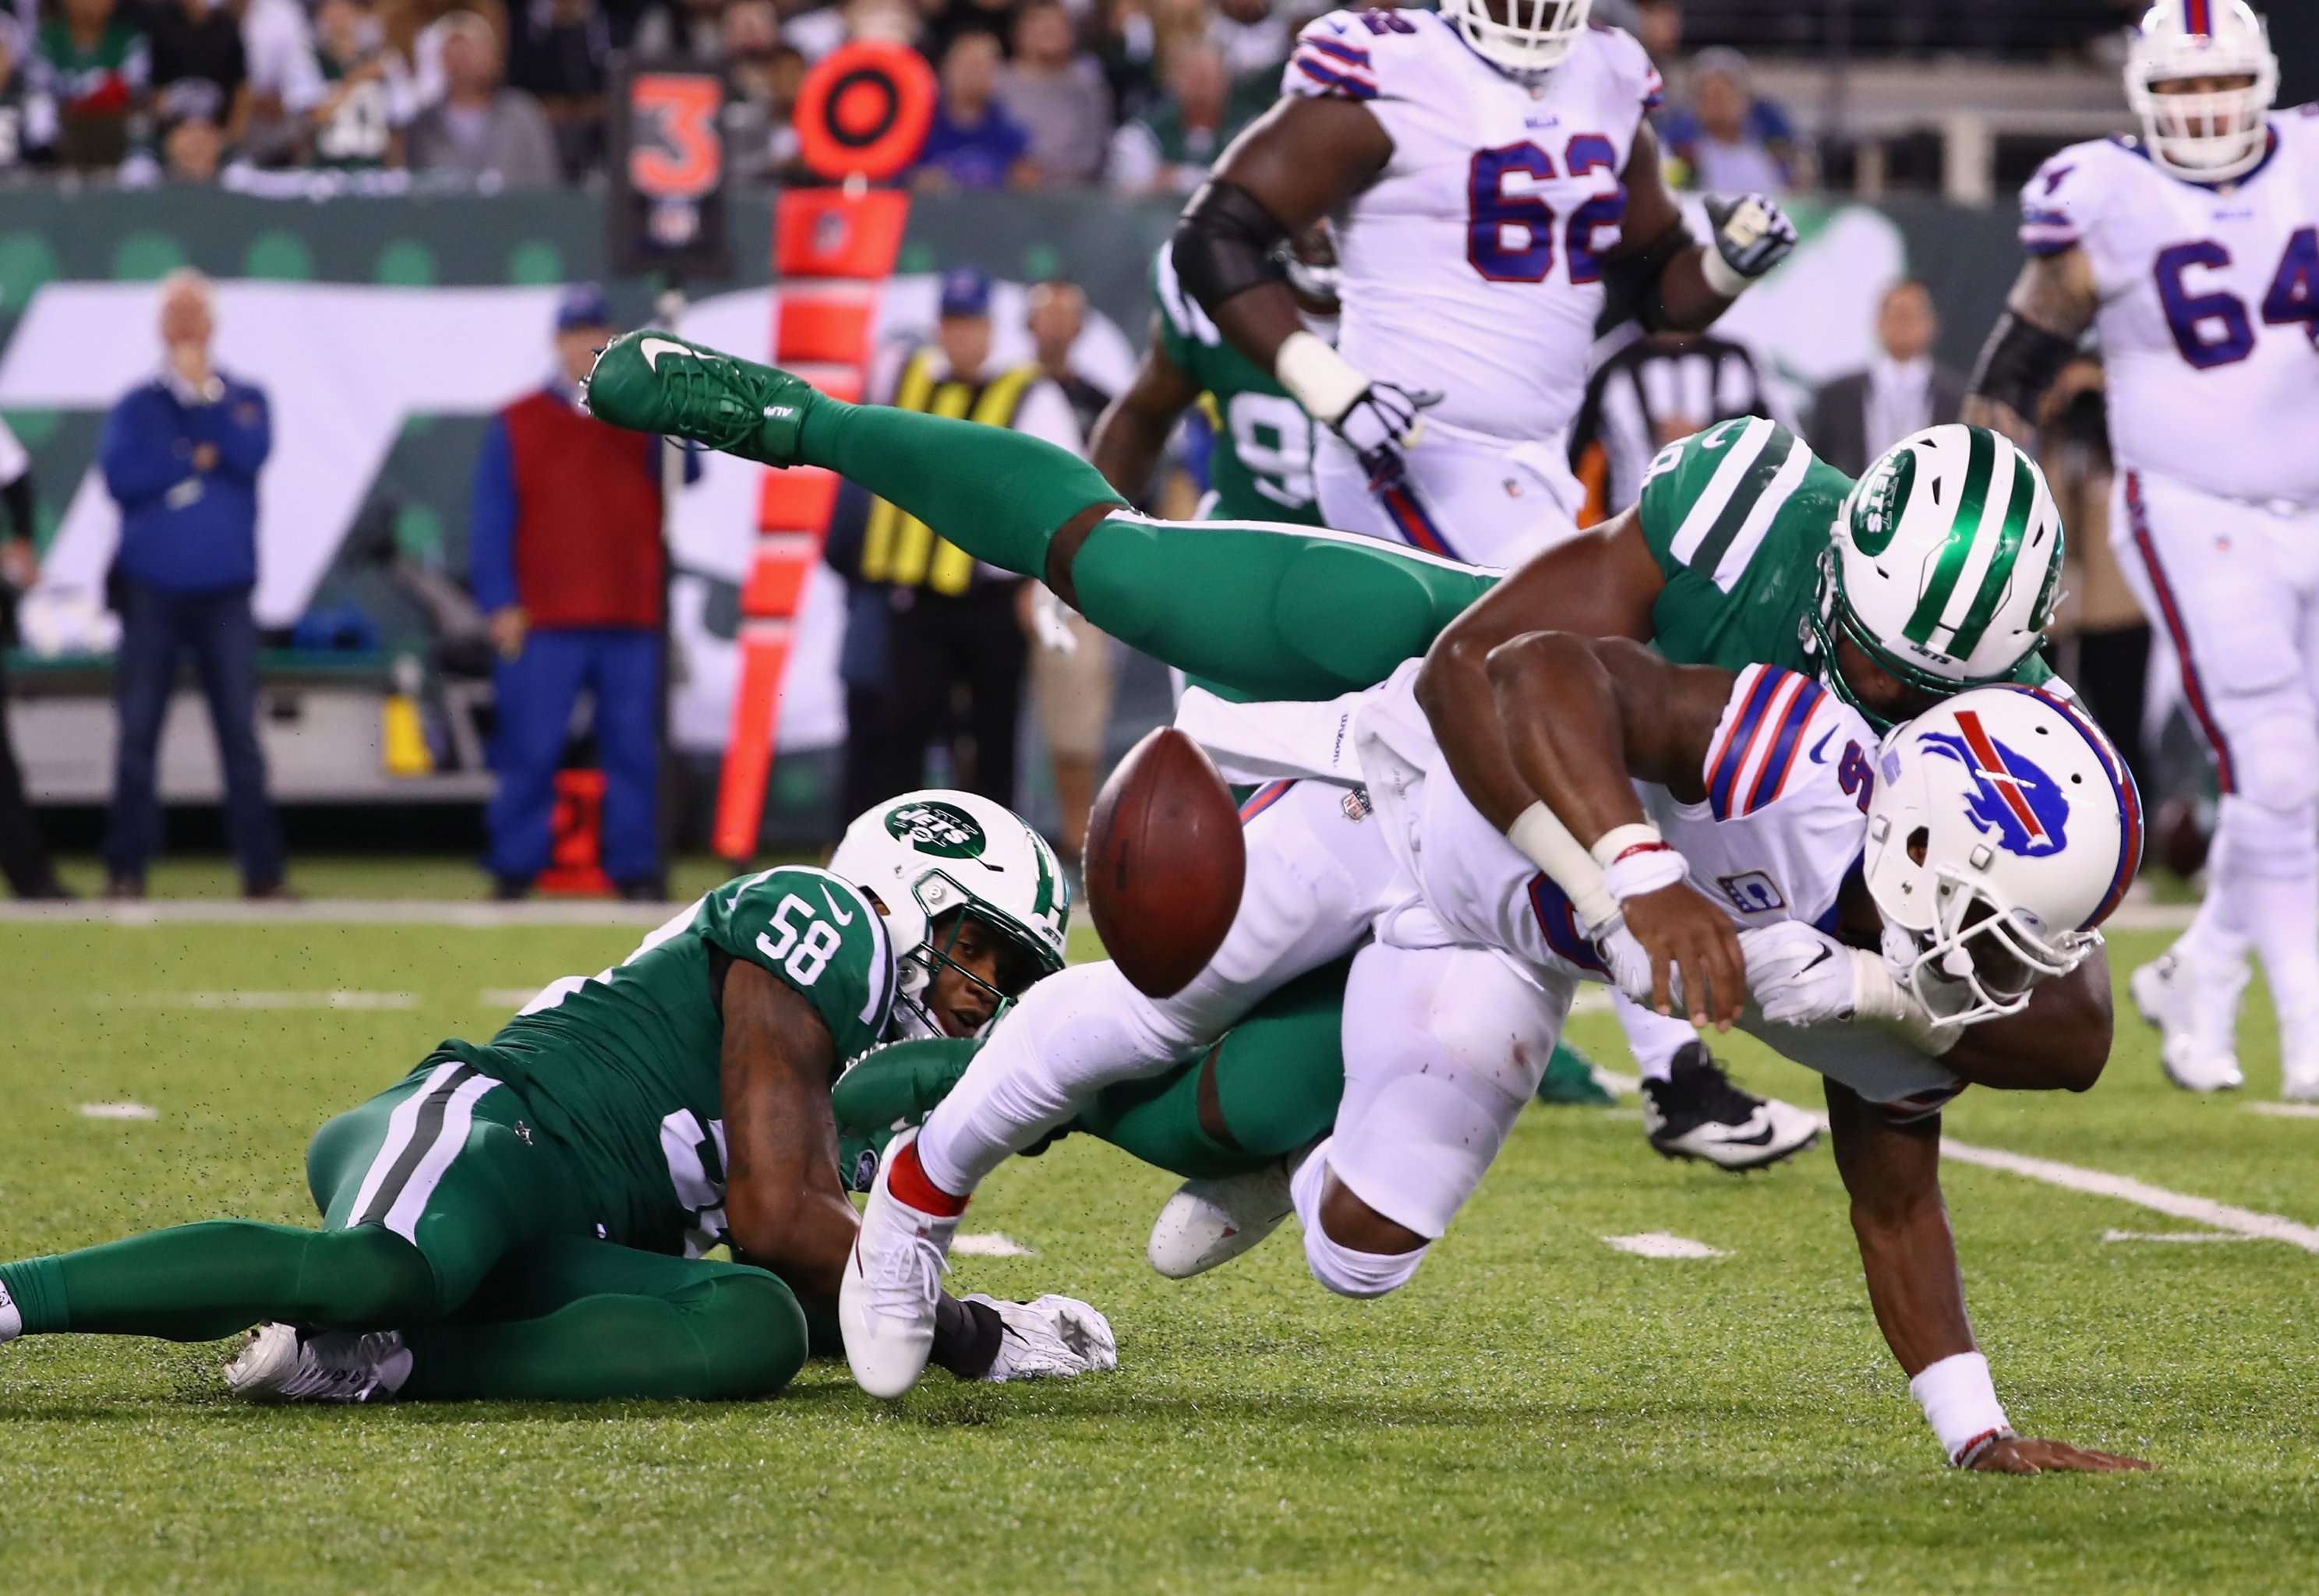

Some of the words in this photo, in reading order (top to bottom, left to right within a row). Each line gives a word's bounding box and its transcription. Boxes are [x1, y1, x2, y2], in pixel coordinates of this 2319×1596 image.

[630, 74, 723, 197] 3
[1468, 134, 1629, 284] 62
[2153, 226, 2319, 369] 64
[1228, 390, 1323, 509] 9
[1868, 449, 1900, 533] JETS
[1910, 645, 1952, 665] JETS
[1838, 739, 1875, 815] 5
[896, 808, 970, 844] JETS
[755, 892, 842, 987] 58
